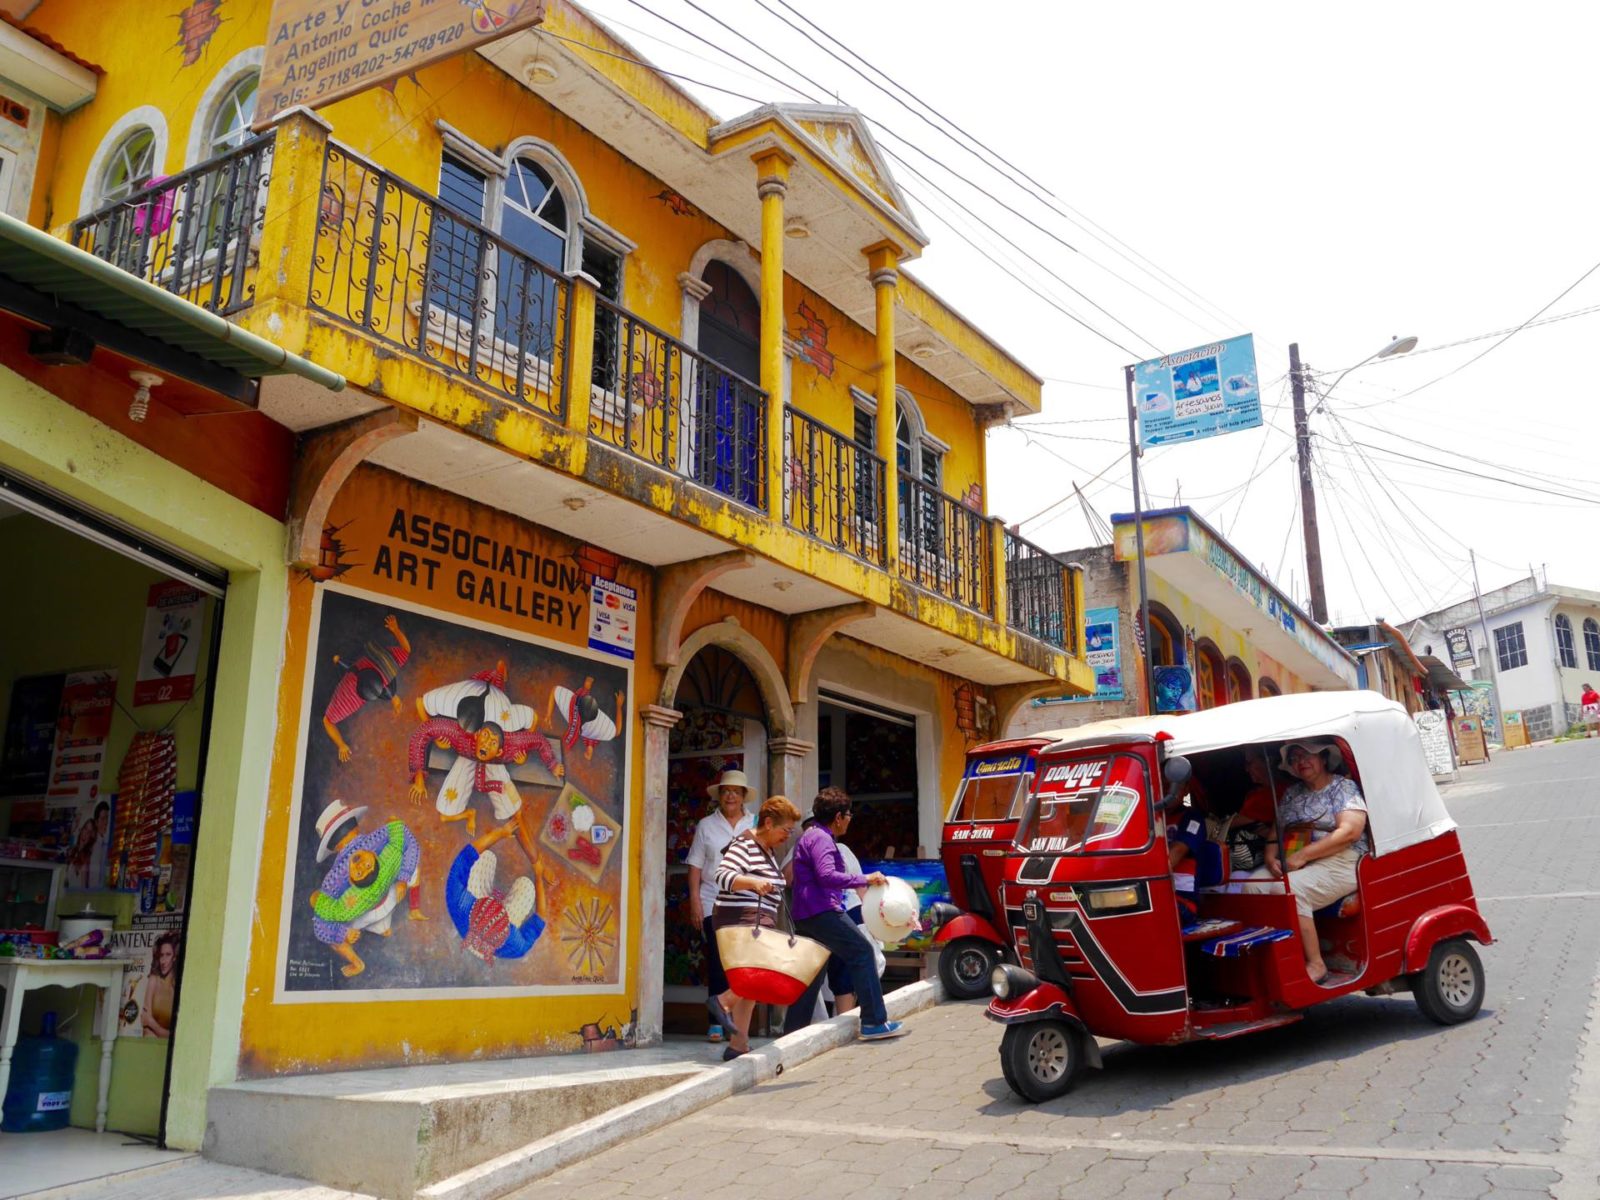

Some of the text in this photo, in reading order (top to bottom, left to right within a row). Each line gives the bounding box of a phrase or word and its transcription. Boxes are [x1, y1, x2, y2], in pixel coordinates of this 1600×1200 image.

[274, 0, 351, 46] Arte y
[285, 0, 411, 64] Antonio Coche
[282, 20, 409, 86] Angelina Quic
[271, 86, 310, 112] Tels:
[1176, 394, 1221, 410] Artesanos
[388, 508, 576, 594] ASSOCIATION
[373, 544, 582, 631] ART GALLERY
[595, 576, 636, 598] Aceptamos
[598, 611, 611, 620] VISA
[622, 602, 636, 612] VISA
[1044, 761, 1107, 788] DOMINIC
[1030, 837, 1069, 852] SAN JUAN
[110, 932, 154, 948] ANTENE
